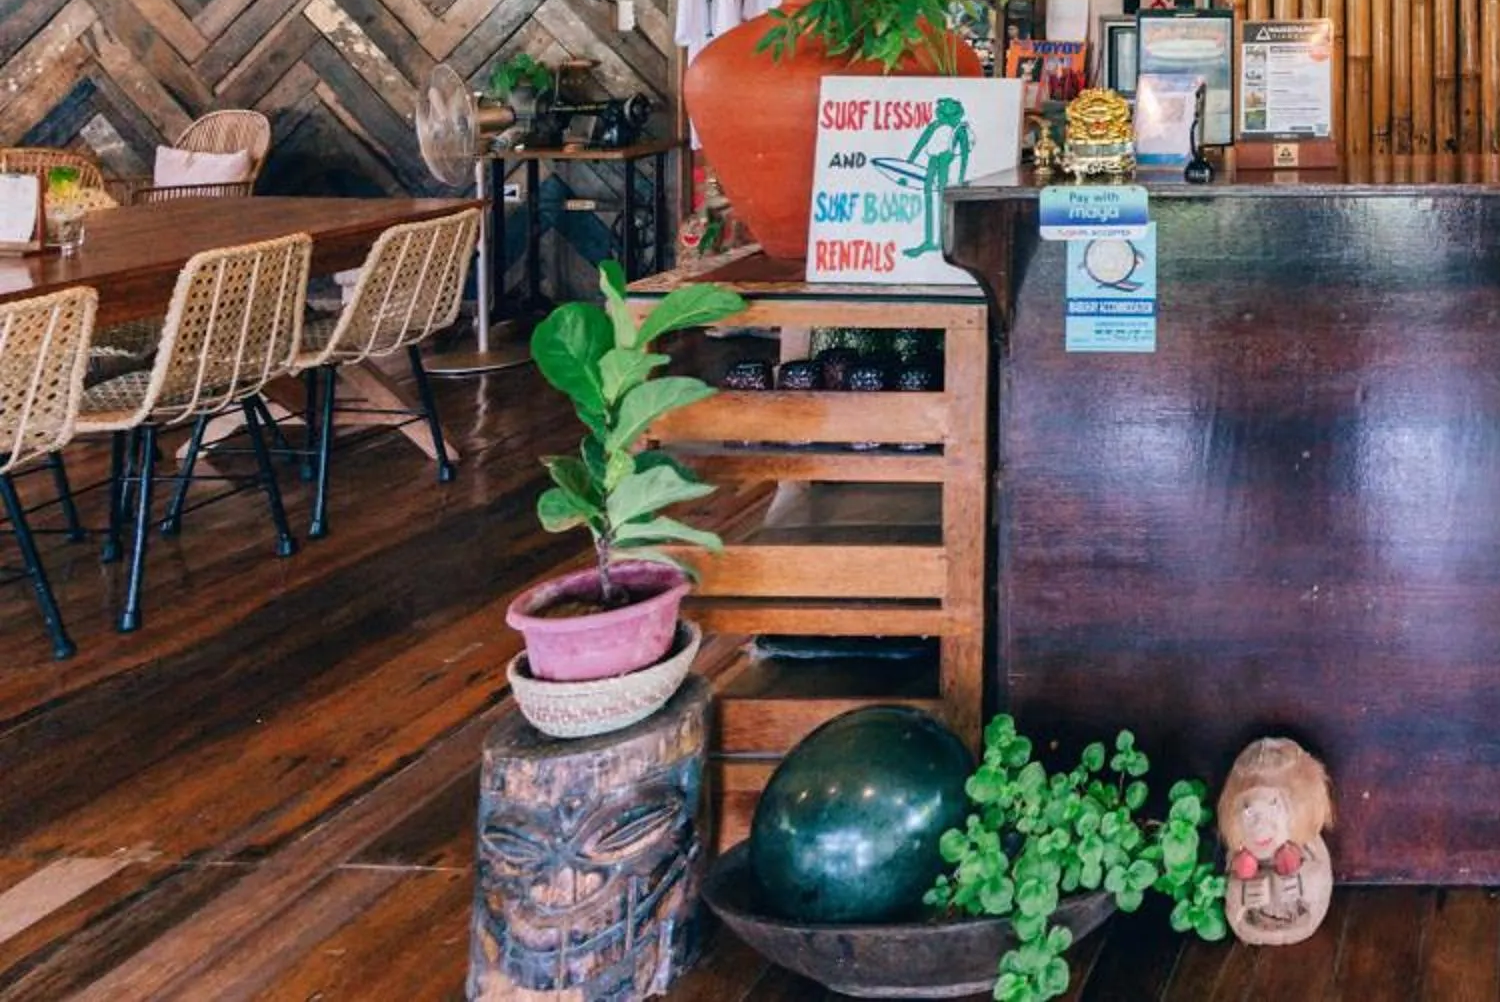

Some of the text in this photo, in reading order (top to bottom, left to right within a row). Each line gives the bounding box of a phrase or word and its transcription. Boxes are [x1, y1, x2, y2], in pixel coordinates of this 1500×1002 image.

[820, 100, 933, 131] SURF LESSON
[828, 152, 867, 168] AND
[814, 191, 922, 225] SURF BOARD
[1069, 191, 1120, 202] Pay with
[1068, 205, 1120, 221] maya
[815, 239, 896, 273] RENTALS
